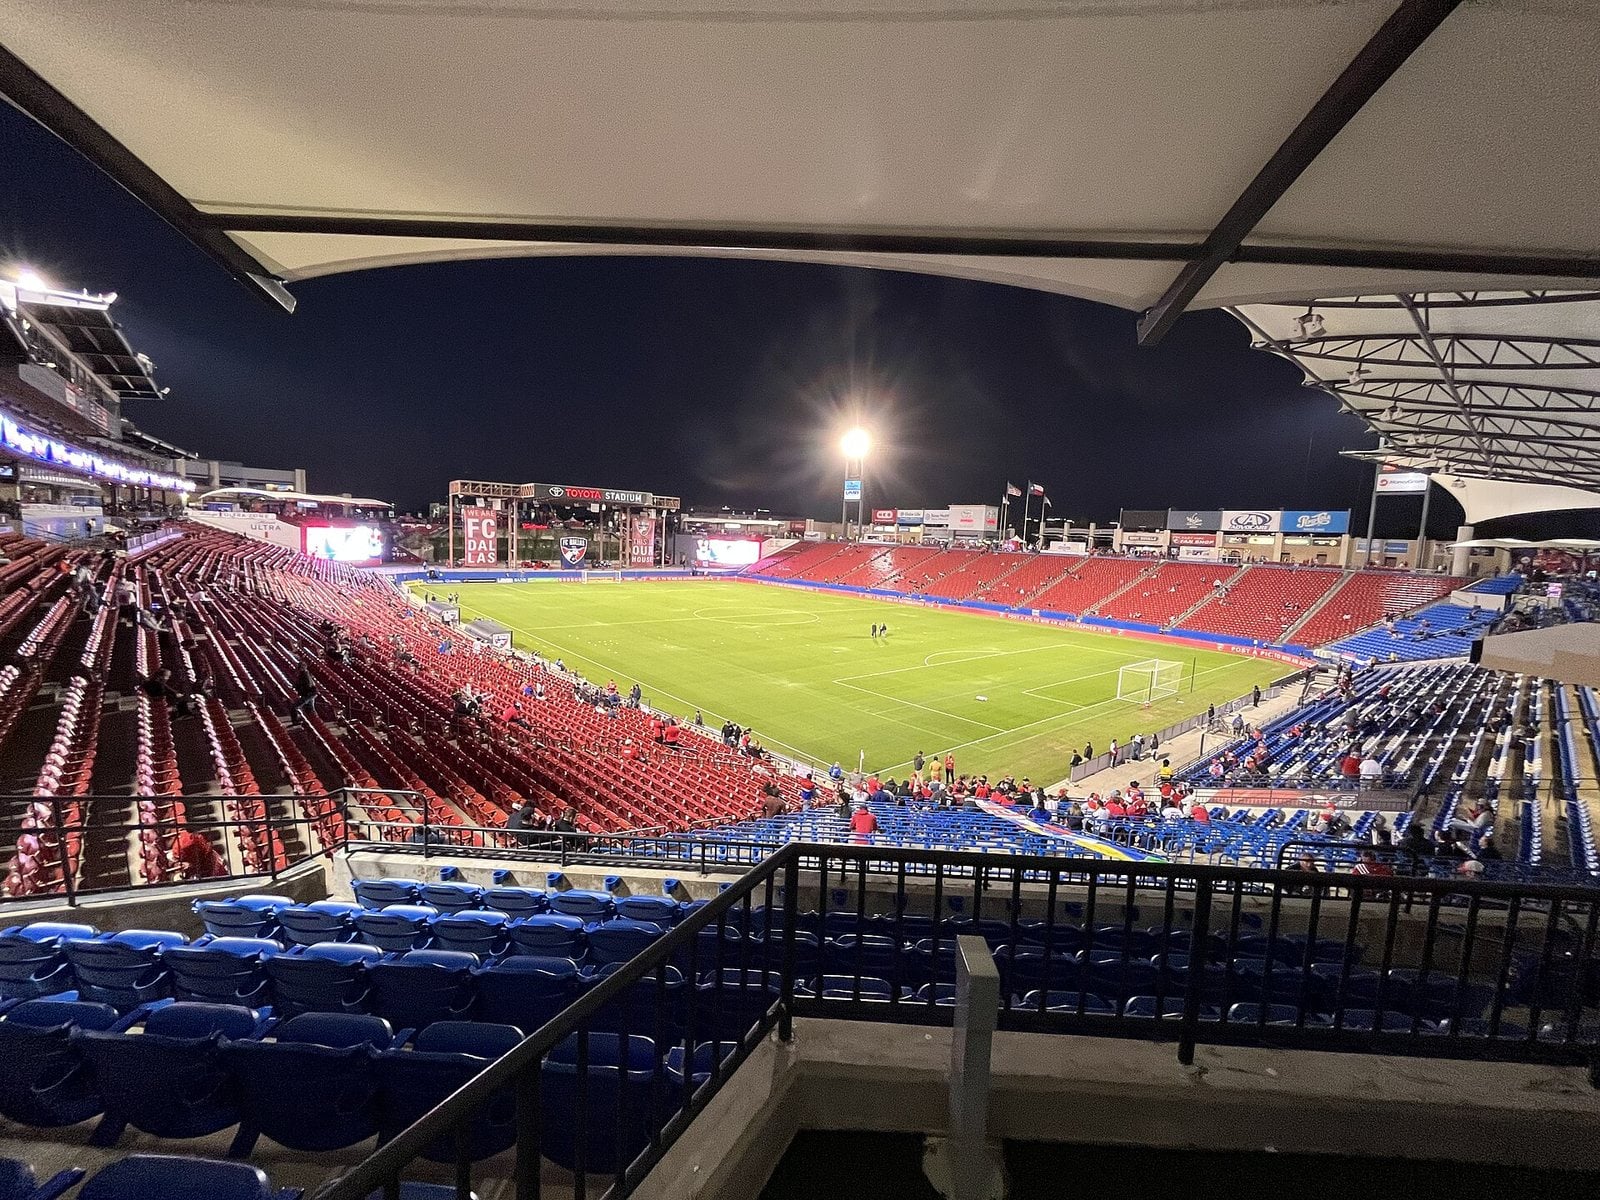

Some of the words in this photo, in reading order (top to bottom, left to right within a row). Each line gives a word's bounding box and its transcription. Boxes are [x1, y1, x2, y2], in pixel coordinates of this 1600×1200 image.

[565, 489, 602, 500] TOYOTA
[605, 491, 642, 502] STADIUM
[467, 518, 495, 539] FC
[468, 539, 495, 551] DAL
[468, 552, 495, 564] LAS
[1231, 646, 1250, 654] POST
[1260, 650, 1272, 658] PIC
